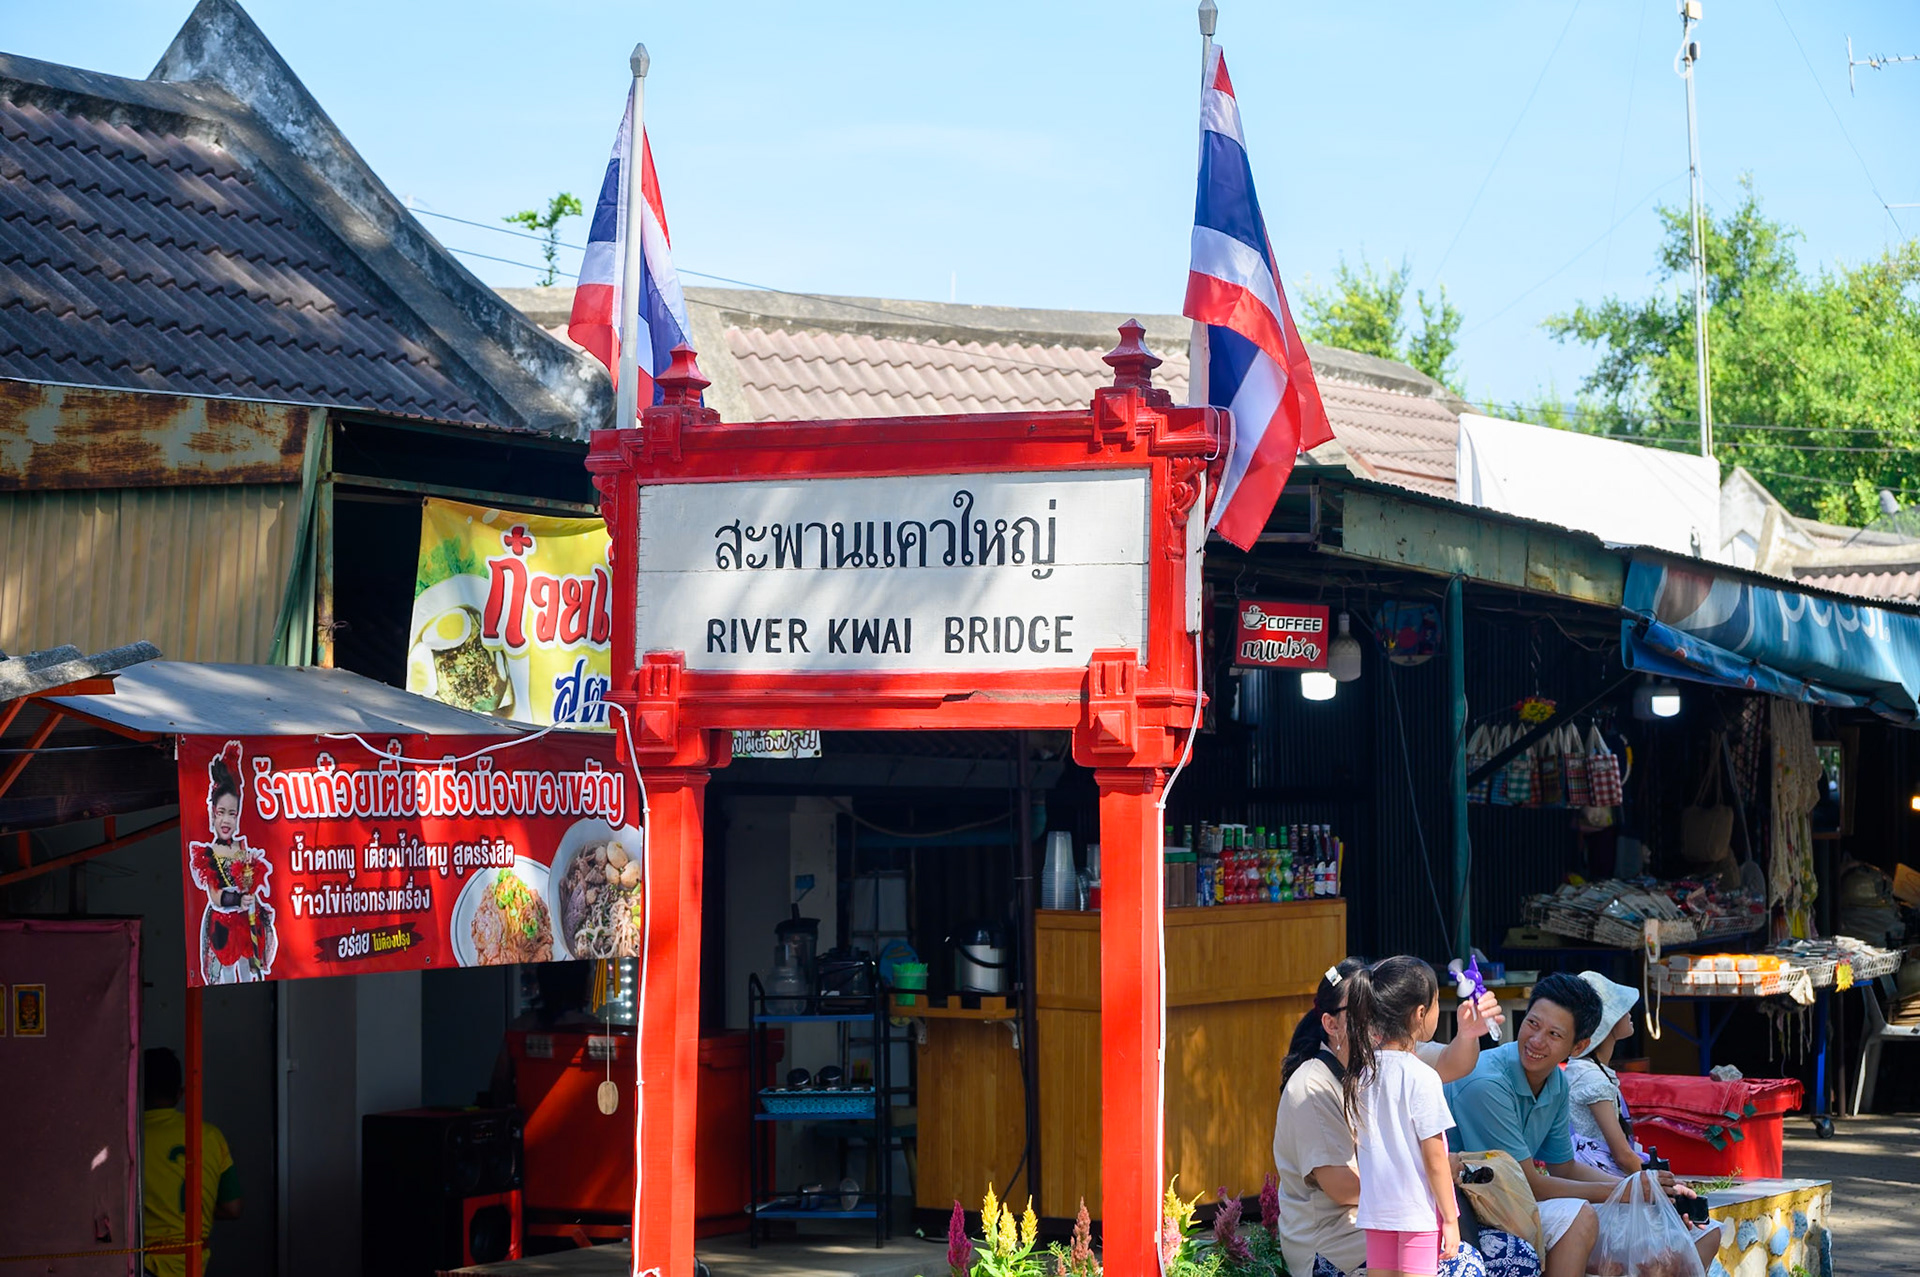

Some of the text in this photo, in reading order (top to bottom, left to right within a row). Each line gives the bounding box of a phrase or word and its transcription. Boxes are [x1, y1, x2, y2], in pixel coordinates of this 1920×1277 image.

[714, 489, 1058, 580] สะพานแควใหญ่
[484, 526, 612, 648] ก๋วยเ
[707, 615, 1075, 654] RIVER KWAI BRIDGE
[1267, 617, 1321, 631] COFFEE
[253, 739, 624, 826] ร้านก๋วยเตี๋ยวเรือน้องของขวัญ
[291, 831, 515, 879] น้ำตกหมู เตี๋ยวน้ำใสหมู สูตรรังสิต
[291, 876, 431, 917] ข้าวไข่เจียวทรงเครื่อง
[338, 927, 411, 958] อร่อย ไม่ต้องปรุง
